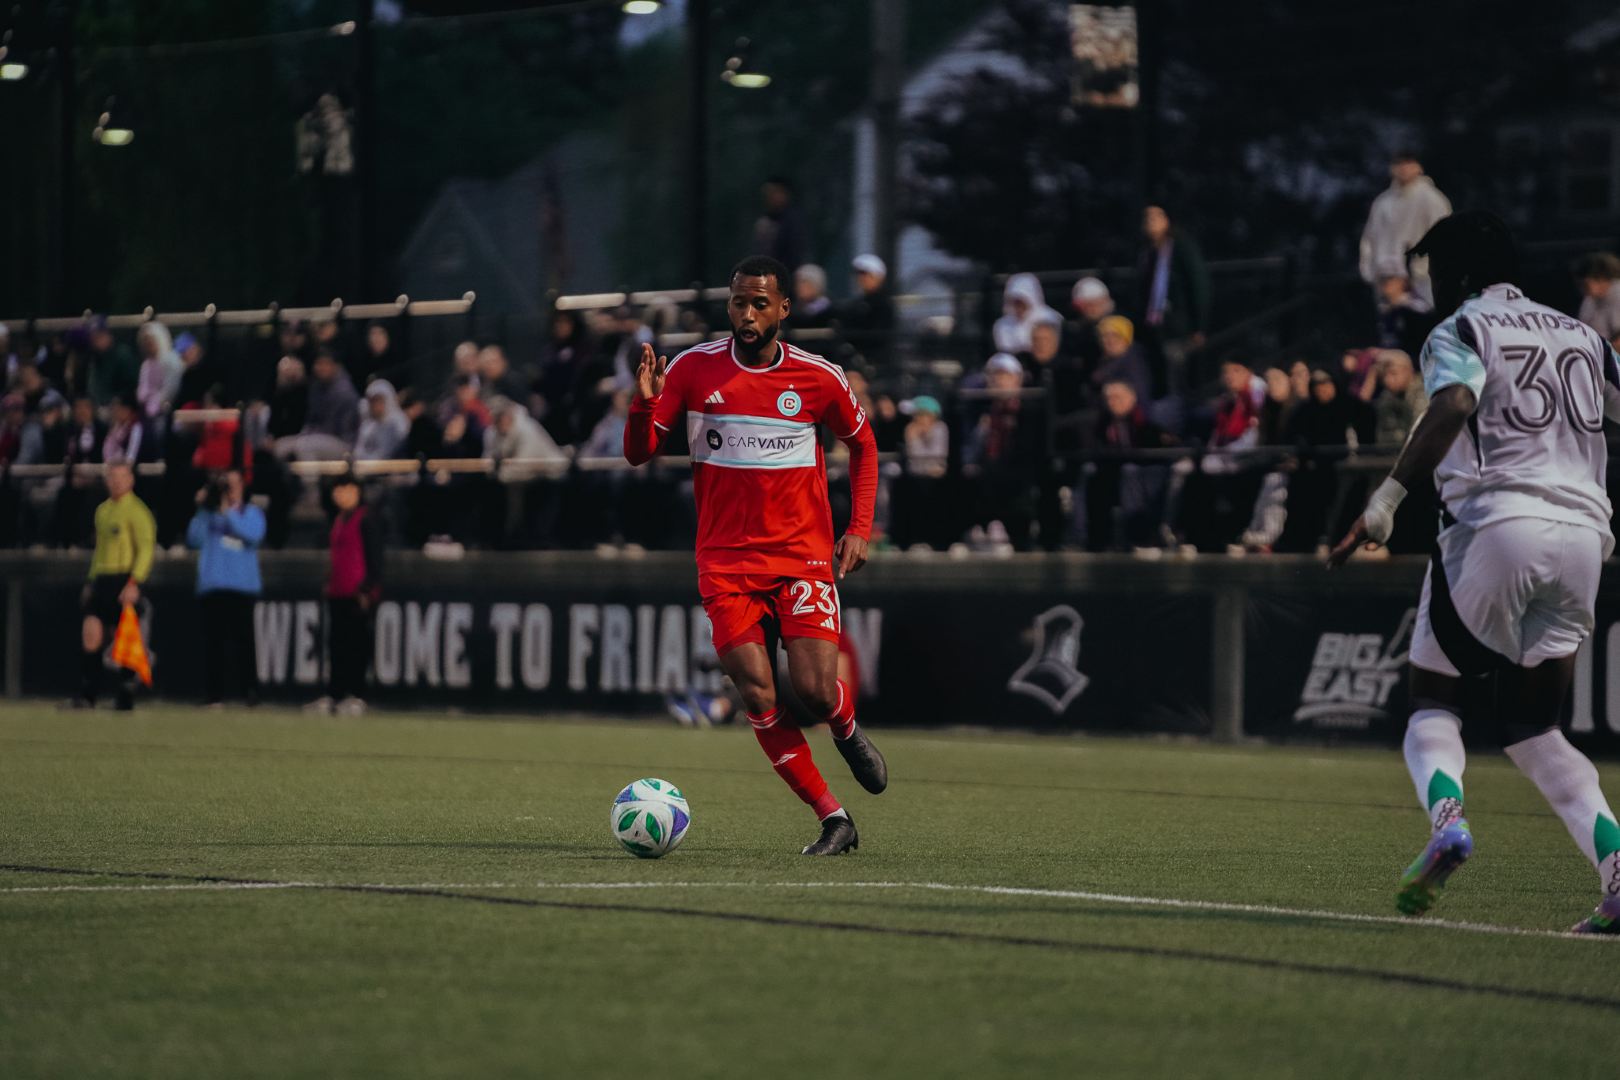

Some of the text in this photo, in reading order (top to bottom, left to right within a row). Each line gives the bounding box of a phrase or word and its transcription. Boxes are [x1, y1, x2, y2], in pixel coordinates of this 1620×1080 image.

[1500, 345, 1604, 434] 30
[727, 435, 795, 450] CARVANA
[790, 580, 836, 615] 23
[253, 601, 473, 687] WEOME
[490, 602, 552, 690] TO
[1312, 632, 1384, 668] BIG
[1302, 668, 1400, 706] EAST
